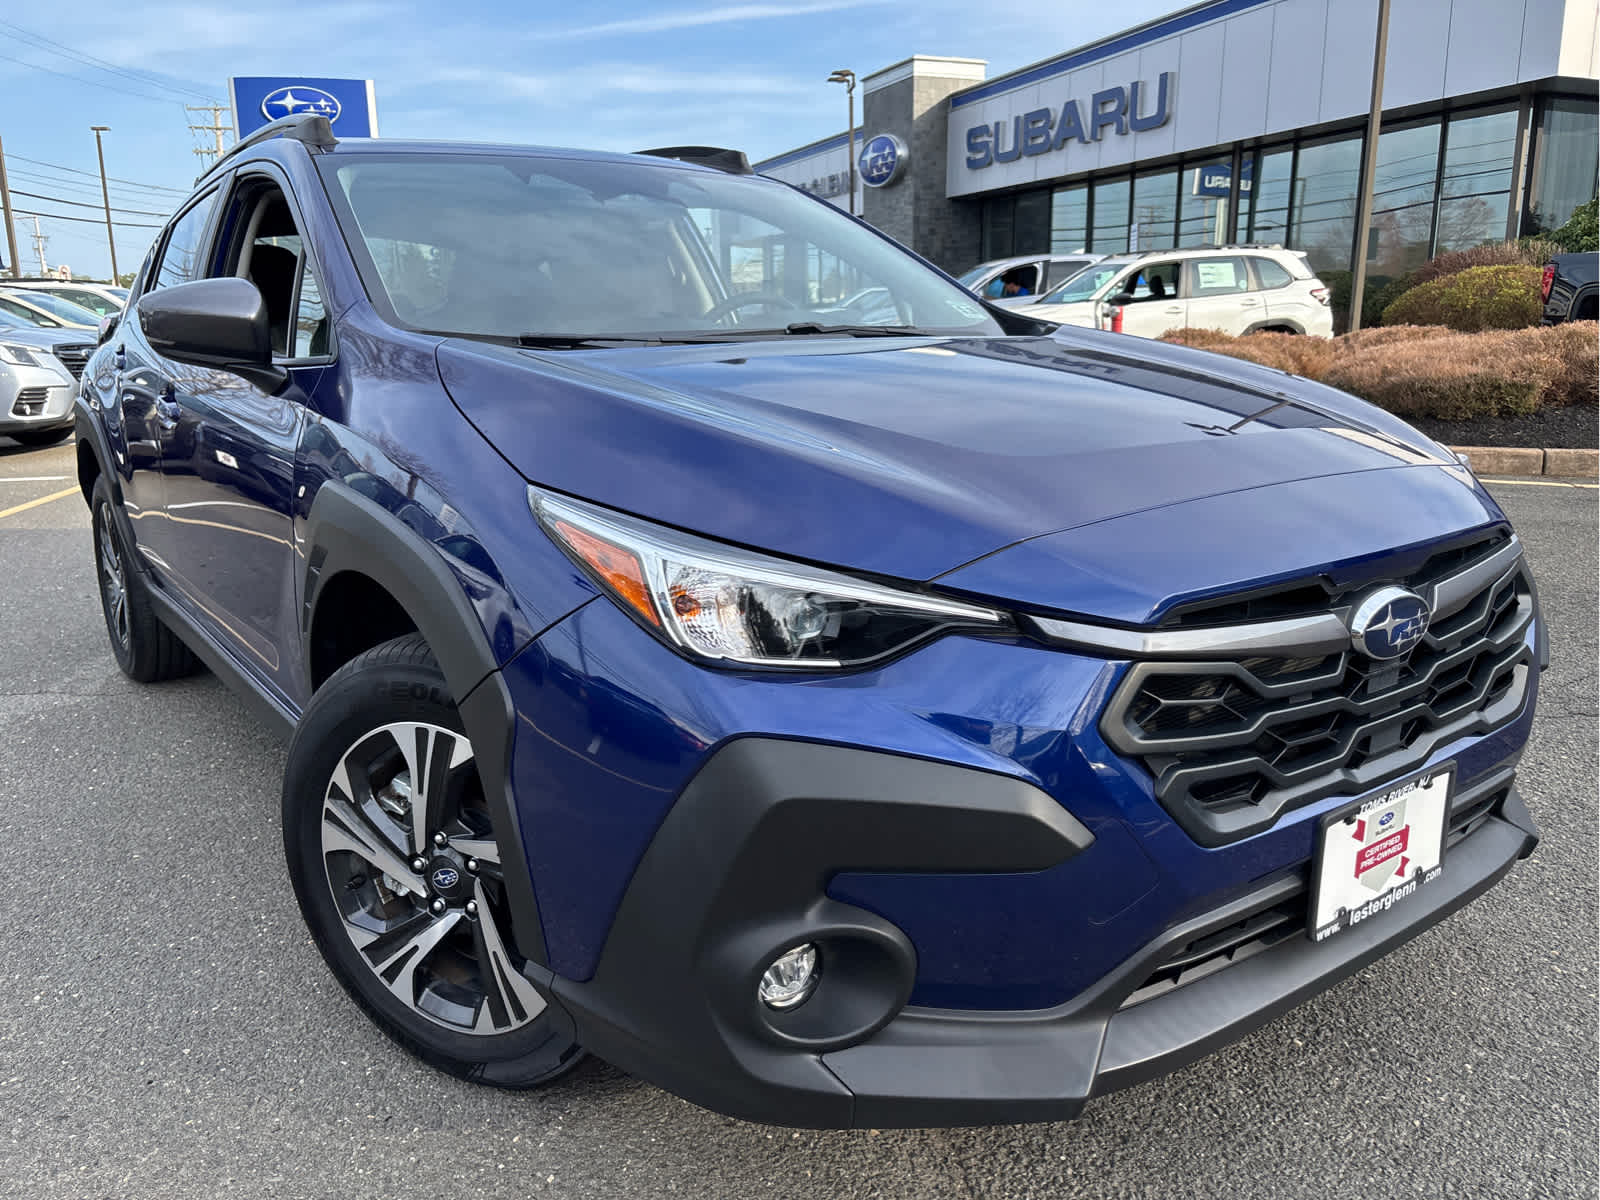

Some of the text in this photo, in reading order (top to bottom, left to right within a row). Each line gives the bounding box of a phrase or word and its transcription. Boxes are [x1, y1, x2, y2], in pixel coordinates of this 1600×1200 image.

[966, 72, 1169, 170] SUBARU
[1418, 774, 1431, 789] NJ
[1360, 842, 1403, 869] PRE-OWNED
[1365, 835, 1401, 858] CERTIFIED
[1349, 881, 1417, 926] lesterglenn
